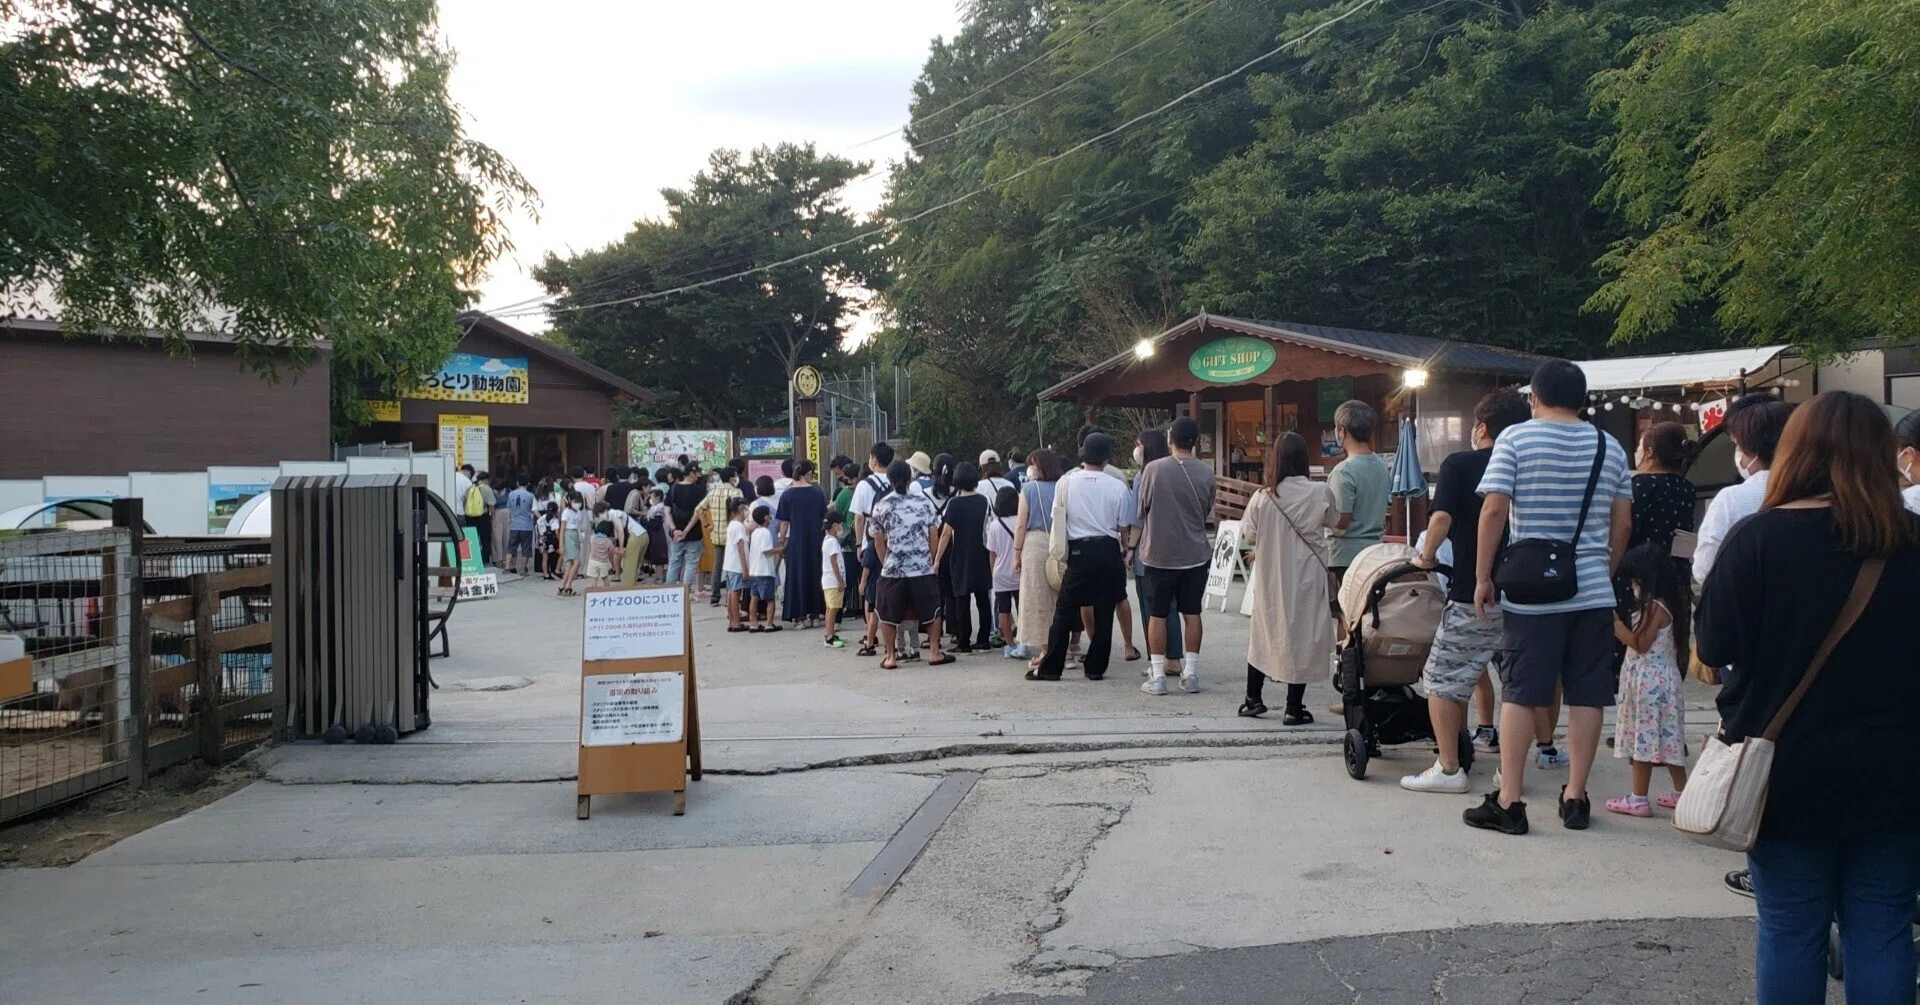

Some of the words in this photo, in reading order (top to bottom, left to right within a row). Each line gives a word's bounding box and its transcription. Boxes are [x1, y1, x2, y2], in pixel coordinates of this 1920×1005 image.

[1202, 355, 1227, 368] GIFT
[1230, 351, 1260, 365] SHOP
[590, 593, 679, 608] ナイトZOOについて
